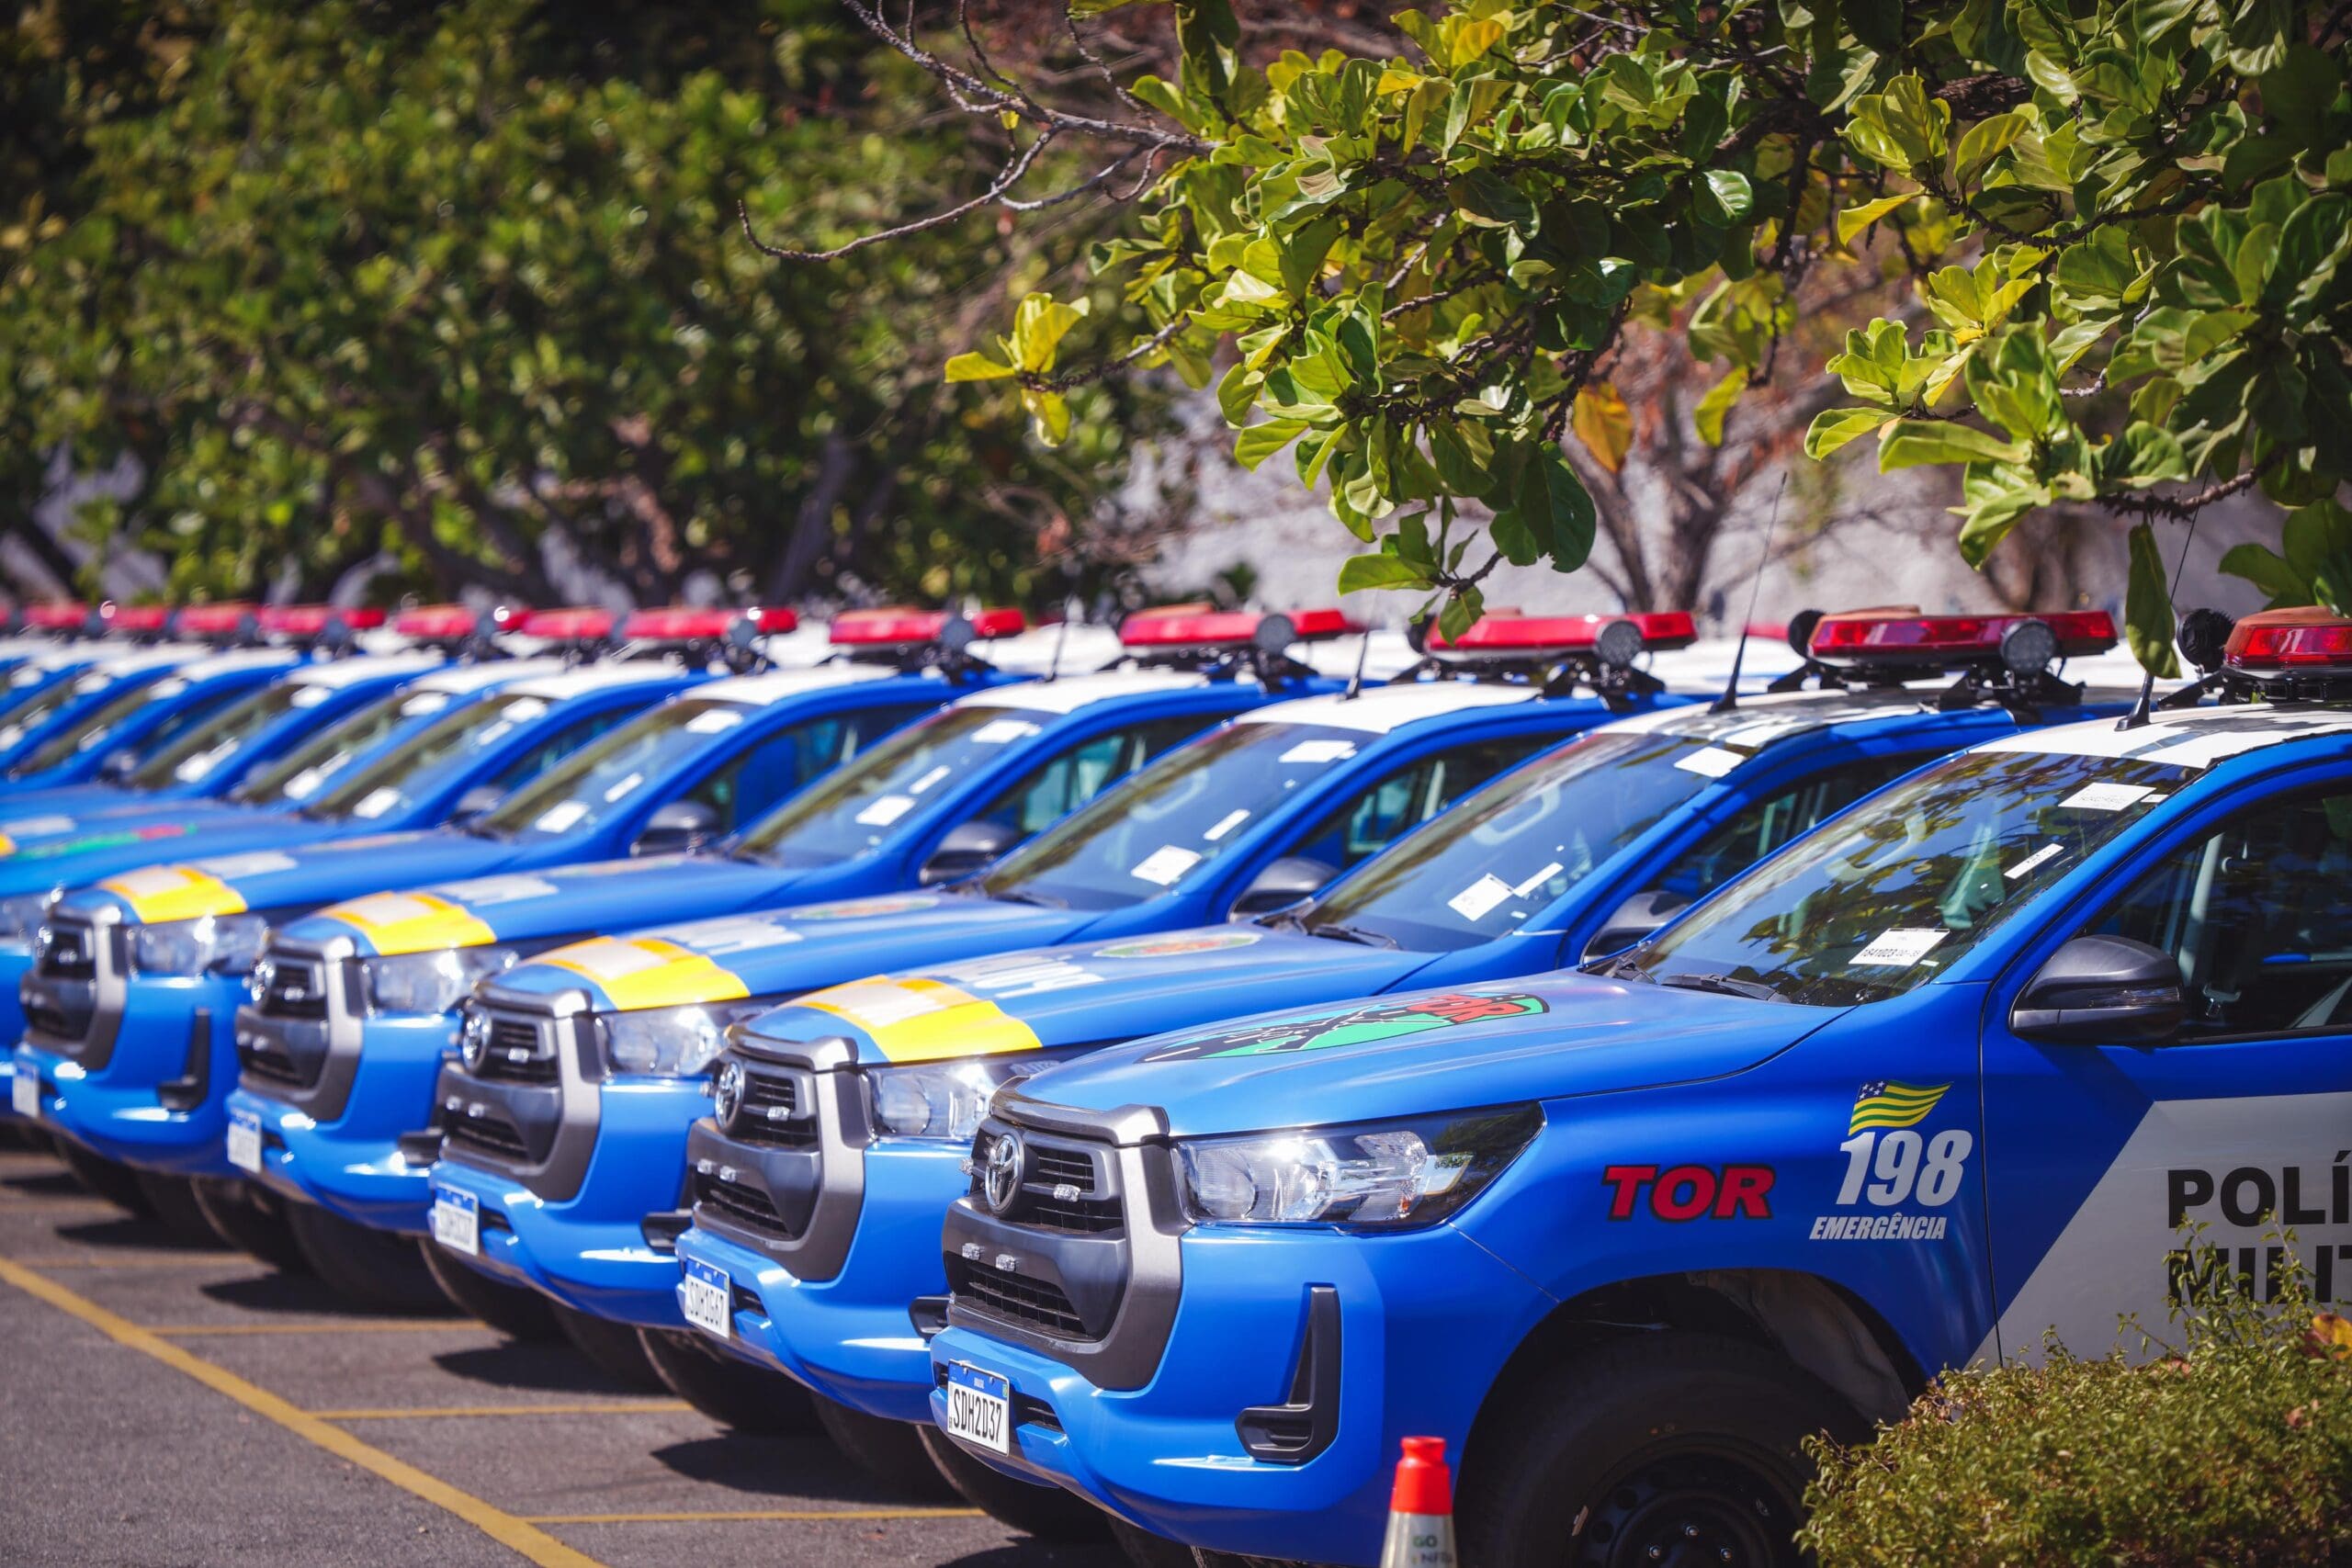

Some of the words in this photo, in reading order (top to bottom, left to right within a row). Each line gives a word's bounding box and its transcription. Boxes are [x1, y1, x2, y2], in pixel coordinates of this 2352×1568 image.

[1601, 1163, 1776, 1223] TOR
[1836, 1130, 1973, 1206] 198
[2167, 1150, 2352, 1228] POLÍ
[1809, 1213, 1947, 1240] EMERGÊNCIA
[2167, 1245, 2352, 1308] MILI
[953, 1388, 1002, 1444] SDH2D37
